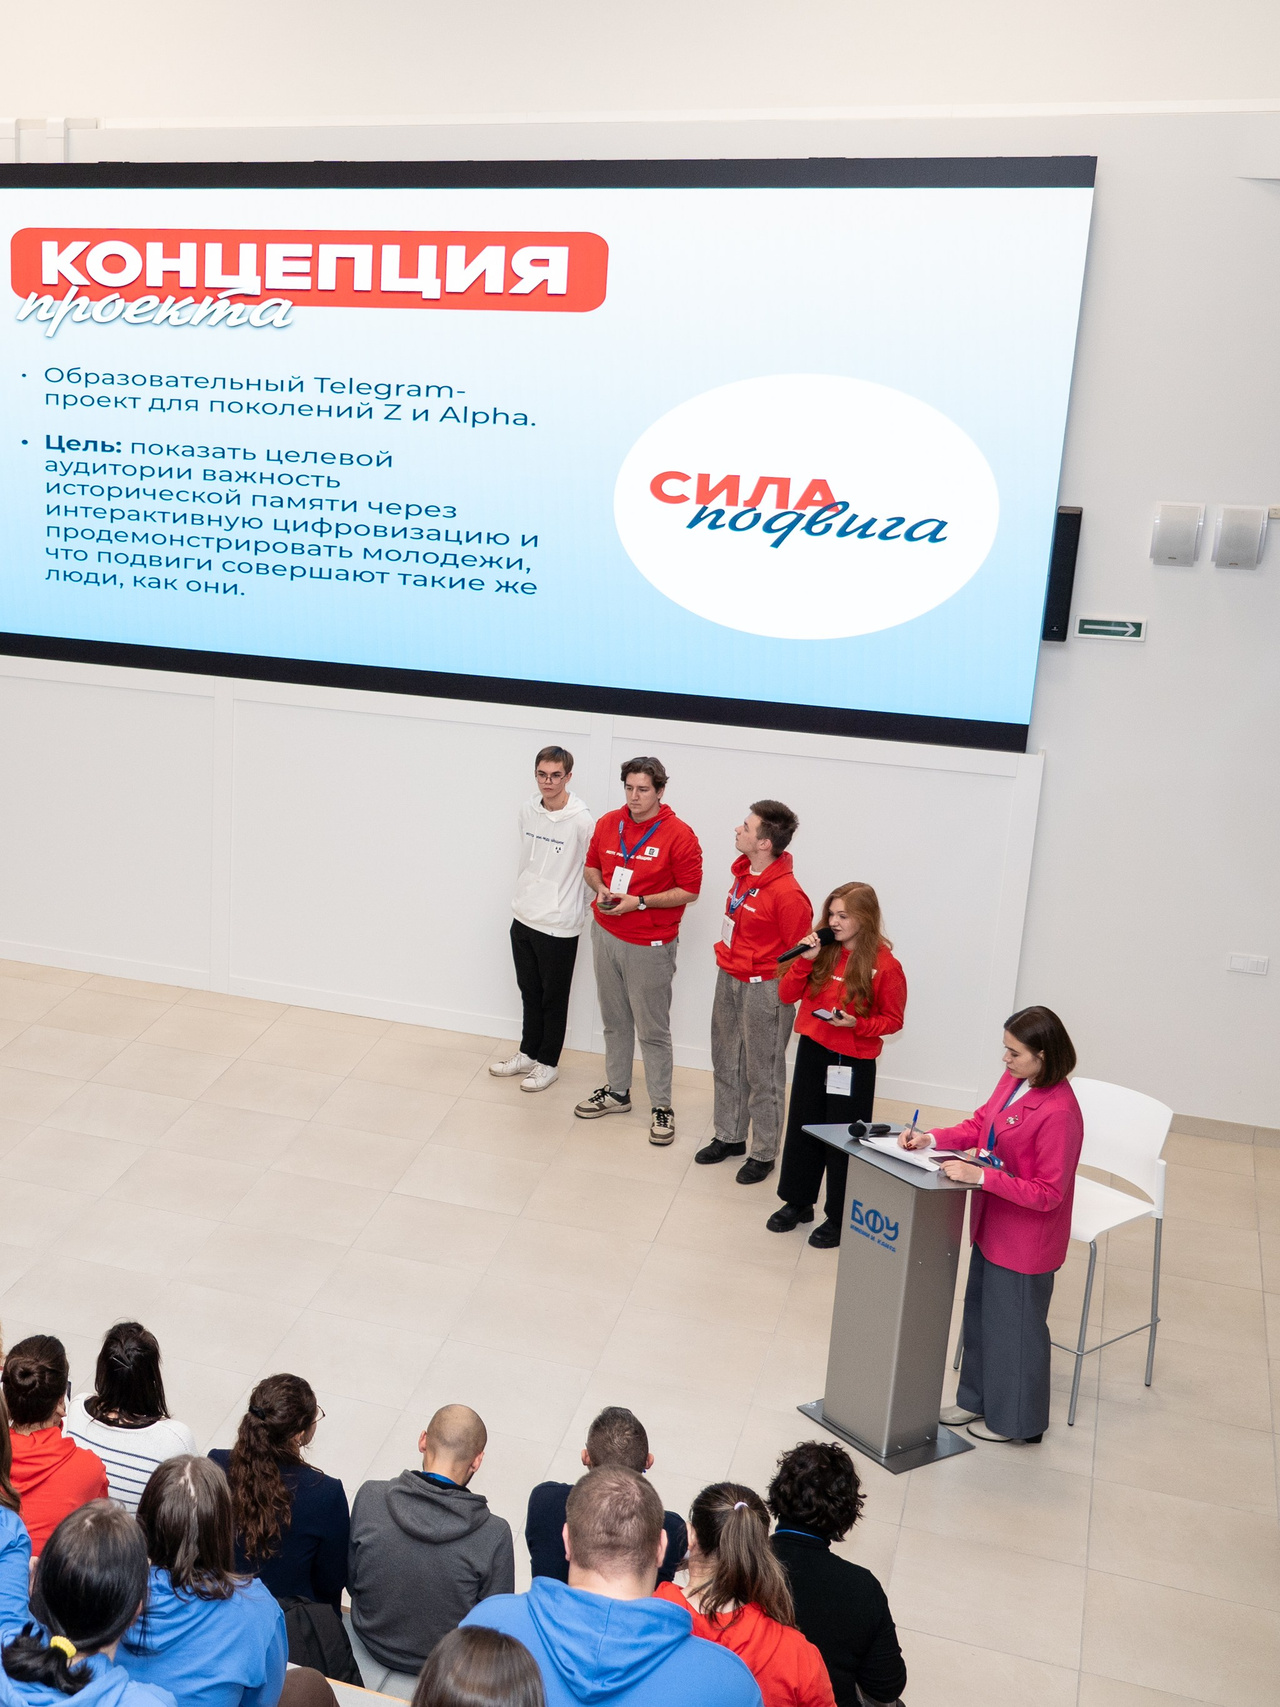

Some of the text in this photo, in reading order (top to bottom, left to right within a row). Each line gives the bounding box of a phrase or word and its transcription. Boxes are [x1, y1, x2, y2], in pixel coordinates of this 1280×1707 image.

[41, 240, 569, 300] КОНЦЕПЦИЯ
[16, 285, 294, 337] проекта
[45, 367, 465, 400] Образовательный Telegram-
[46, 393, 535, 428] проект для поколений Z и Alpha.
[46, 435, 392, 468] Цель: показать целевой
[45, 460, 340, 488] аудитории важность
[649, 470, 841, 513] СИЛА
[46, 482, 456, 520] исторической памяти через
[47, 504, 538, 547] интерактивную цифровизацию и
[686, 500, 948, 549] подвига
[46, 547, 537, 595] что подвиги совершают такие же
[47, 526, 530, 574] продемонстрировать молодежи,
[45, 569, 245, 596] люди, как они.
[851, 1199, 899, 1241] БФУ
